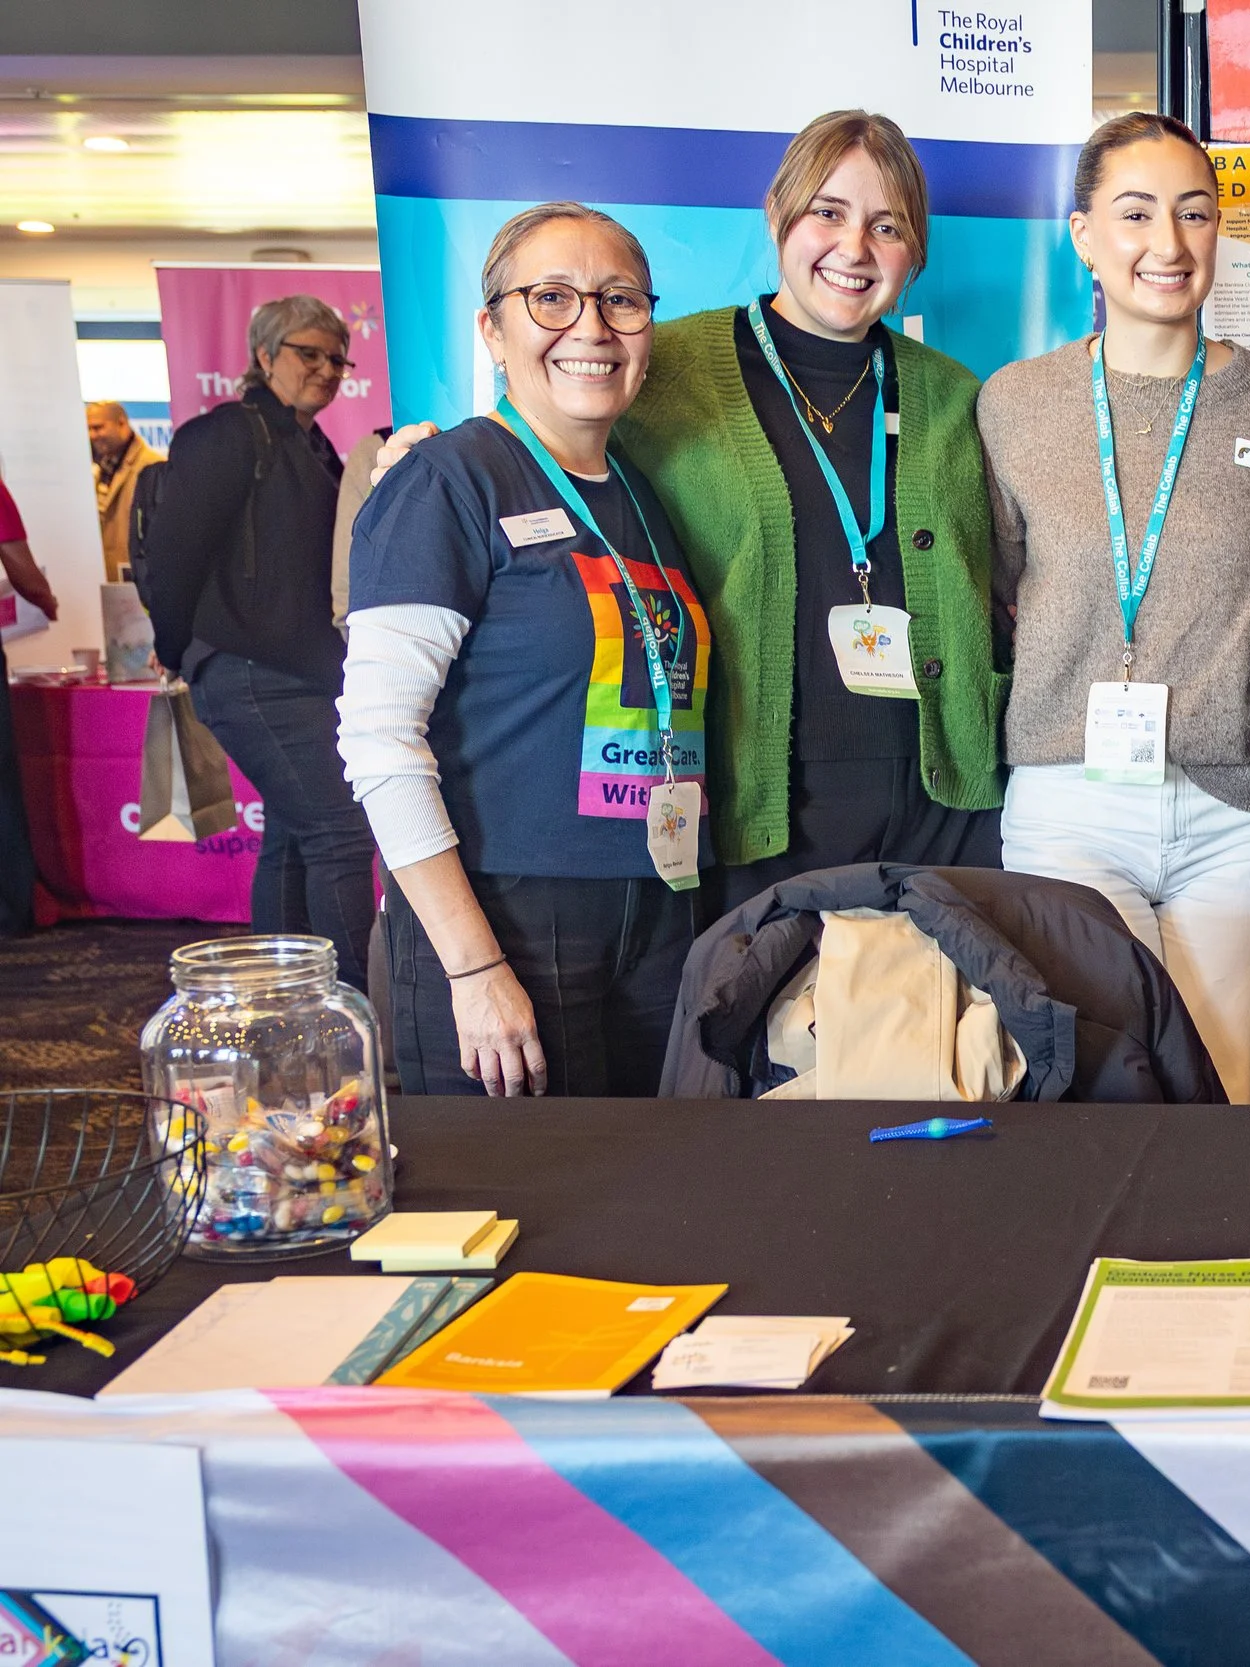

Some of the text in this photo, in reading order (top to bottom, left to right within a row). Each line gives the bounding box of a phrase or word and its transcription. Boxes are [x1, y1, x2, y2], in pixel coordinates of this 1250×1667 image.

[938, 10, 1022, 34] The Royal
[939, 33, 1032, 53] Children's
[940, 53, 1014, 75] Hospital
[940, 76, 1034, 96] Melbourne
[754, 321, 784, 379] The Collab
[1094, 376, 1104, 400] The
[1096, 401, 1111, 440] Collab
[1173, 379, 1198, 438] The Collab
[1102, 455, 1120, 516] The Collab
[1153, 455, 1178, 516] The Collab
[1113, 533, 1130, 601] The Collab
[1132, 534, 1158, 598] The Collab
[643, 616, 666, 689] The Collab
[601, 742, 665, 766] Great
[602, 783, 647, 805] Wit
[196, 836, 261, 858] supe
